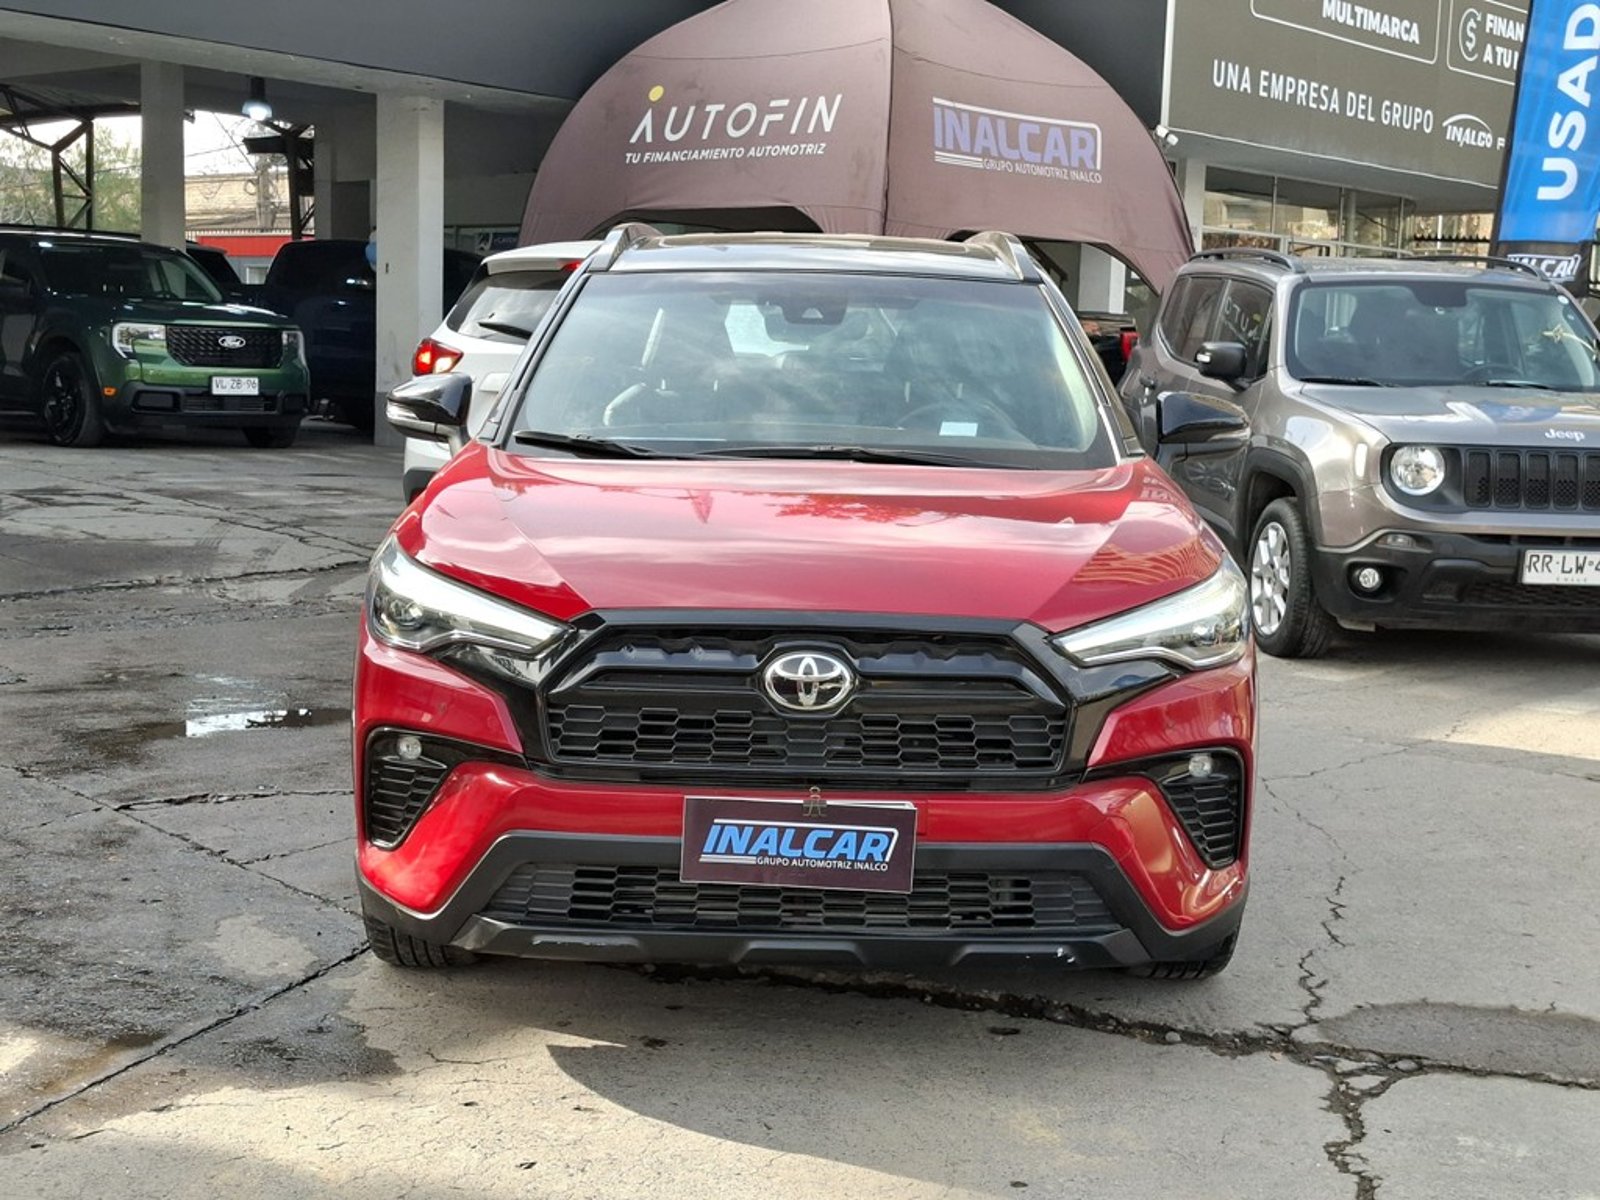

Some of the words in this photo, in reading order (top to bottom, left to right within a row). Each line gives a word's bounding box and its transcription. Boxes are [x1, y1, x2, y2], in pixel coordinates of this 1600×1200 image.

[1322, 0, 1420, 44] MULTIMARCA
[1483, 44, 1493, 64] A
[1495, 46, 1512, 69] TU
[629, 90, 843, 143] AUTOFIN
[1213, 59, 1251, 93] UNA
[1259, 69, 1340, 114] EMPRESA
[1346, 91, 1375, 122] DEL
[1381, 100, 1434, 134] GRUPO
[1445, 125, 1493, 148] INALCO
[933, 106, 1095, 169] INALCAR
[625, 152, 641, 164] TU
[643, 147, 745, 163] FINANCIAMIENTO
[747, 143, 827, 158] AUTOMOTRIZ
[983, 159, 1014, 173] GRUPO
[1014, 163, 1069, 180] AUTOMOTRIZ
[1070, 171, 1102, 184] INALCO
[1544, 428, 1585, 442] Jeep
[703, 824, 890, 861] INALCAR
[757, 856, 790, 867] GRUPO
[790, 857, 851, 870] AUTOMOTRIZ
[854, 862, 889, 872] INALCO
